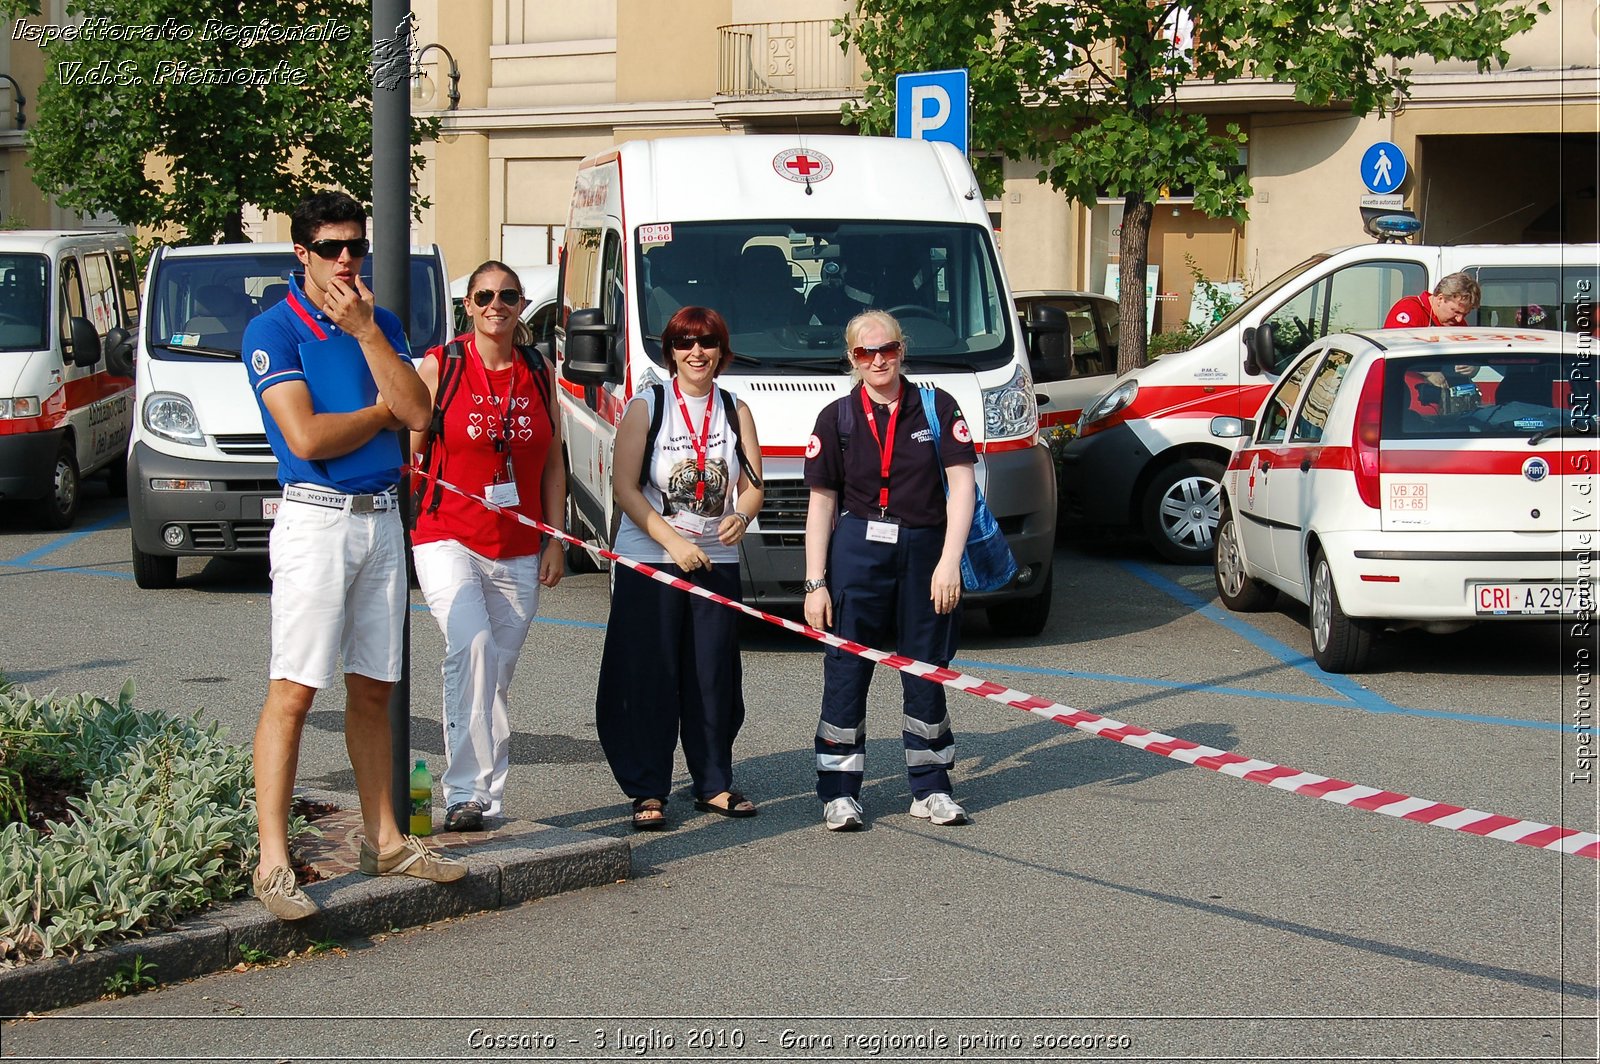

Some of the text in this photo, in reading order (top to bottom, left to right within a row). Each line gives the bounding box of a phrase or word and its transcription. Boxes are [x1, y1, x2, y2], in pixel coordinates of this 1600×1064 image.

[911, 85, 951, 140] P
[642, 234, 670, 242] 10-66
[1111, 229, 1121, 237] CO
[1528, 466, 1544, 475] FIAT
[1393, 485, 1424, 496] VB 28
[264, 502, 279, 515] CR
[1480, 587, 1510, 609] CRI
